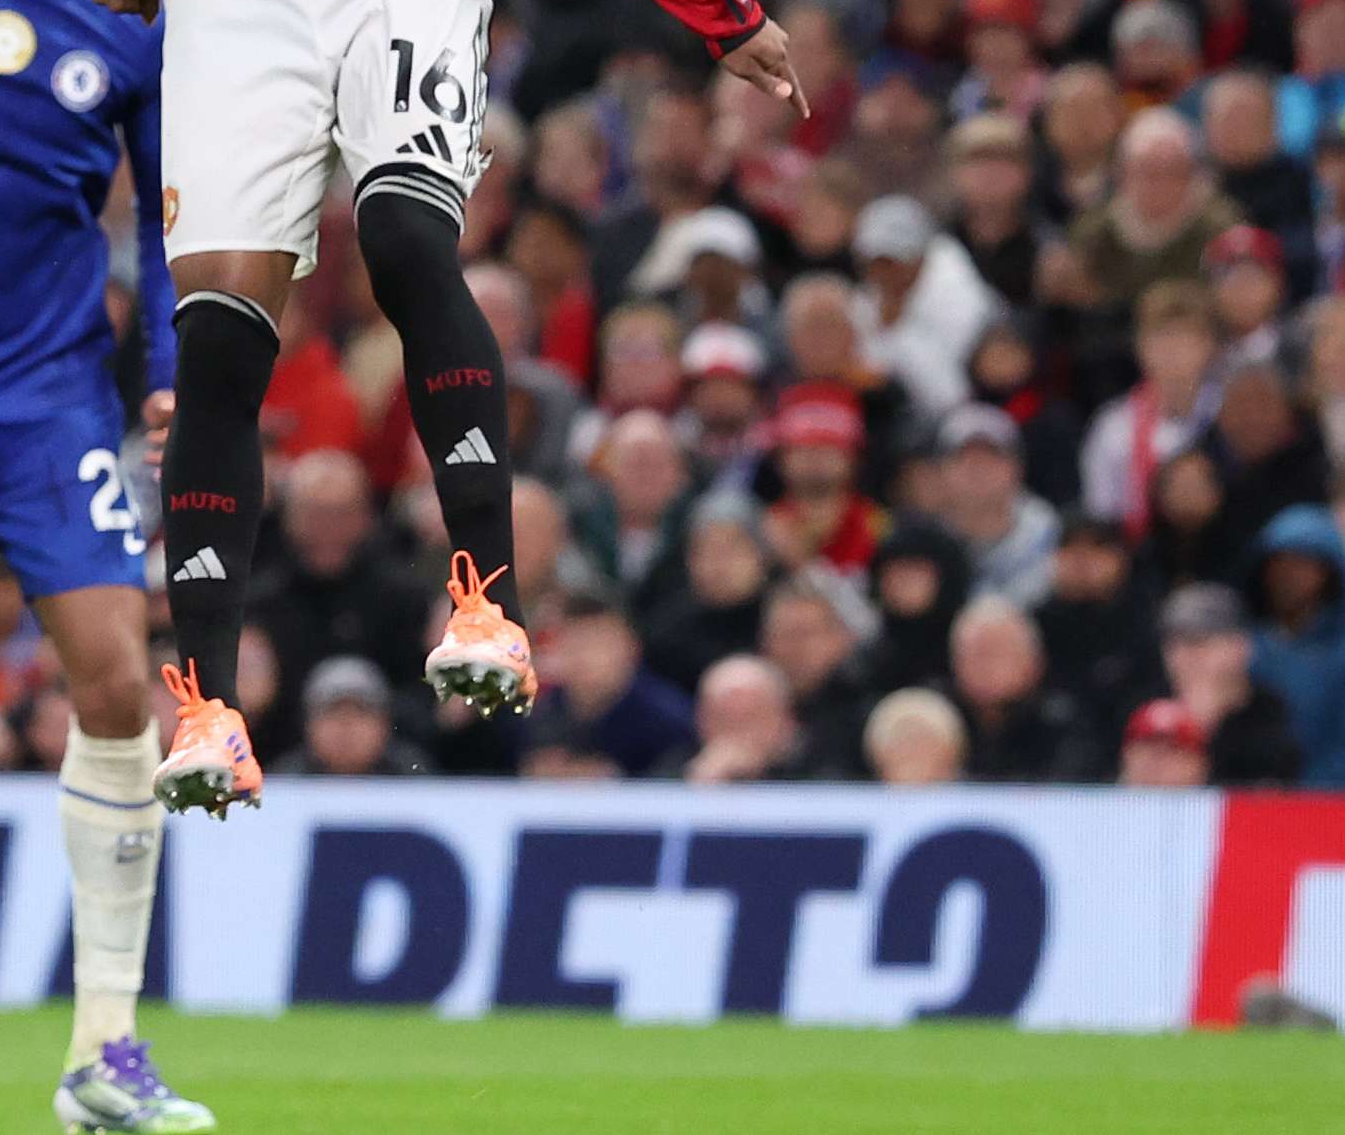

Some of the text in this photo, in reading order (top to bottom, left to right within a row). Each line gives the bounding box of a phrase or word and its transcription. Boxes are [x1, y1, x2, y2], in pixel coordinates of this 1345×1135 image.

[390, 38, 467, 124] 16
[424, 367, 494, 394] MUFC
[77, 447, 147, 556] 2
[170, 491, 238, 513] MUFC
